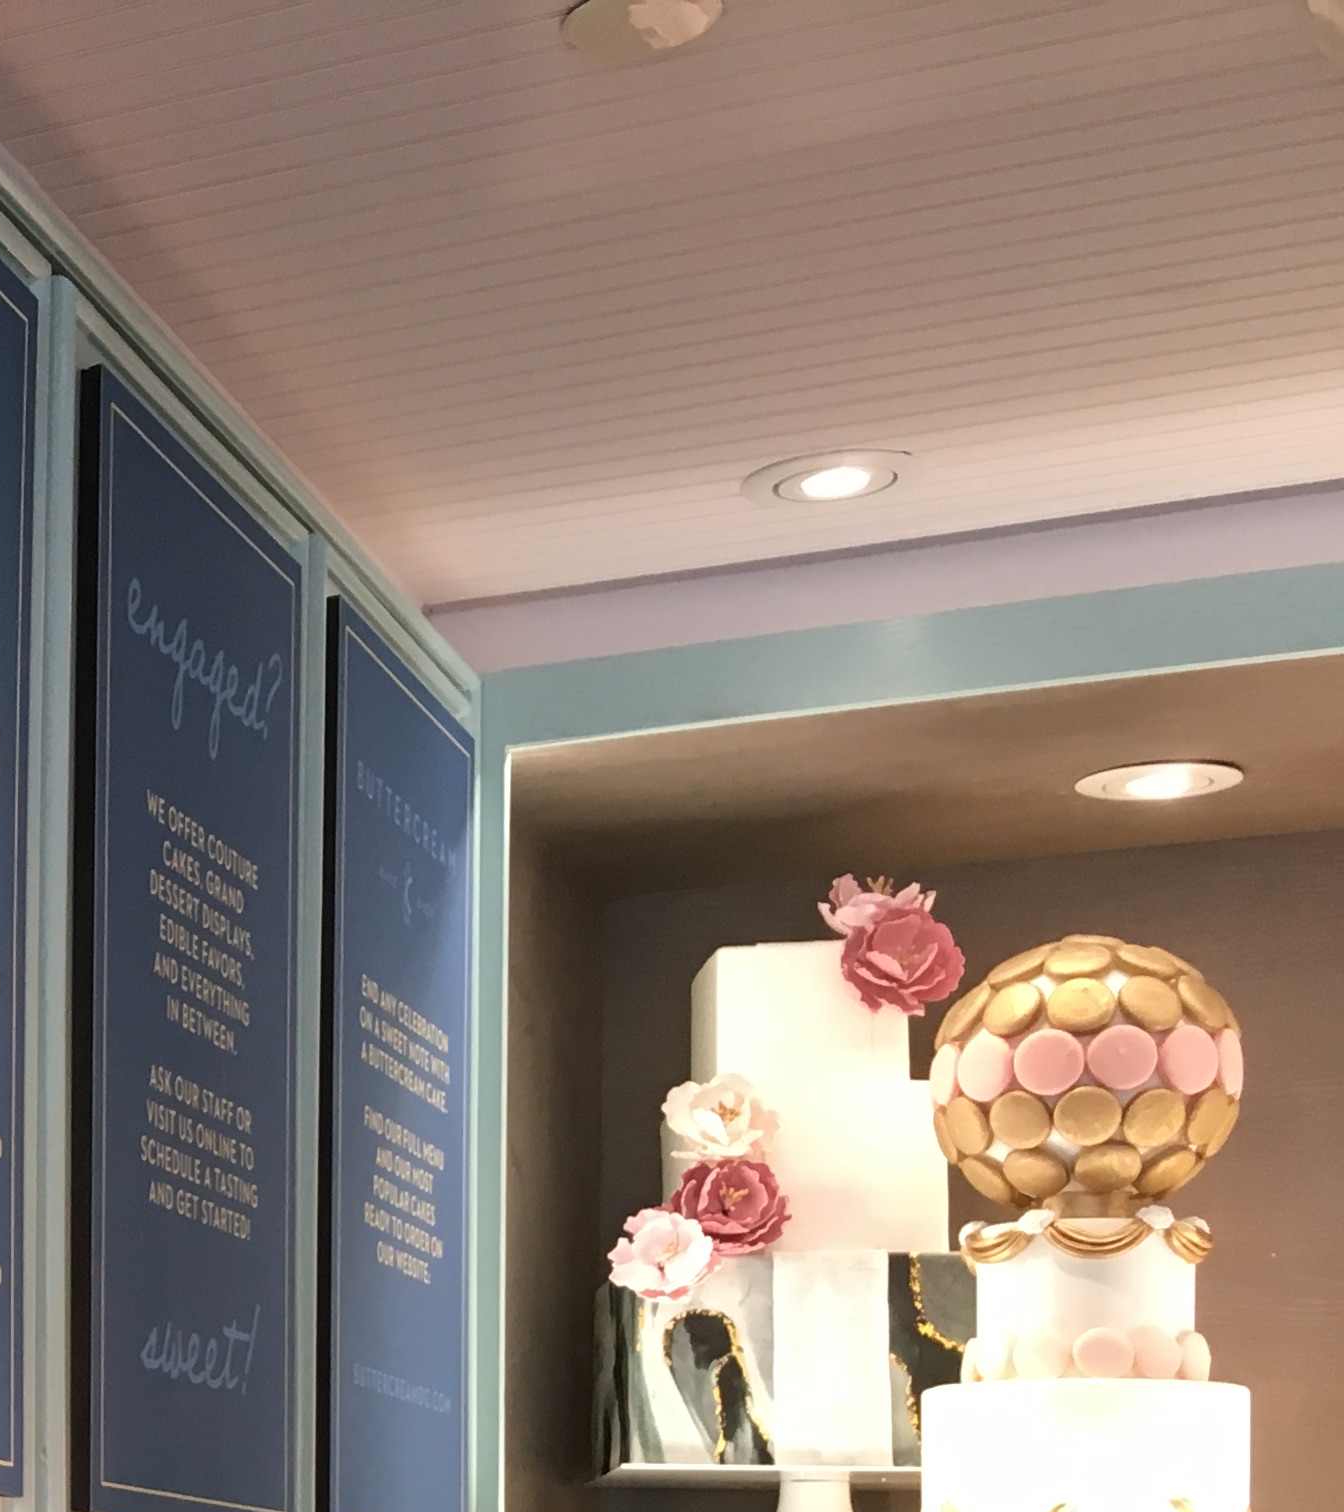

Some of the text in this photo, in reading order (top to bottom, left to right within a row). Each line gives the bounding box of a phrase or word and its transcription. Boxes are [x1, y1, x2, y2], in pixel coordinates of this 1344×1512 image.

[127, 577, 283, 760] engaged?
[147, 789, 258, 891] WE OFFER COUTURE
[357, 759, 457, 876] BUTTERCREAM
[162, 840, 244, 914] CAKES, GRAND
[149, 868, 254, 960] DESSERT DISPLAYS,
[159, 913, 245, 990] EDIBLE FAVORS,
[154, 951, 250, 1027] AND EVERYTHING
[167, 994, 238, 1056] IN BETWEEN.
[398, 1001, 449, 1053] CELEBRATION
[149, 1064, 252, 1135] ASK OUR STAFF OR
[369, 1043, 425, 1099] BUTTERCREAM
[146, 1099, 254, 1170] VISIT US ONLINE TO
[141, 1135, 258, 1208] SCHEDULE A TASTING
[149, 1180, 251, 1241] AND GET STARTED!
[392, 1215, 403, 1240] TO
[140, 1303, 261, 1396] sweet!
